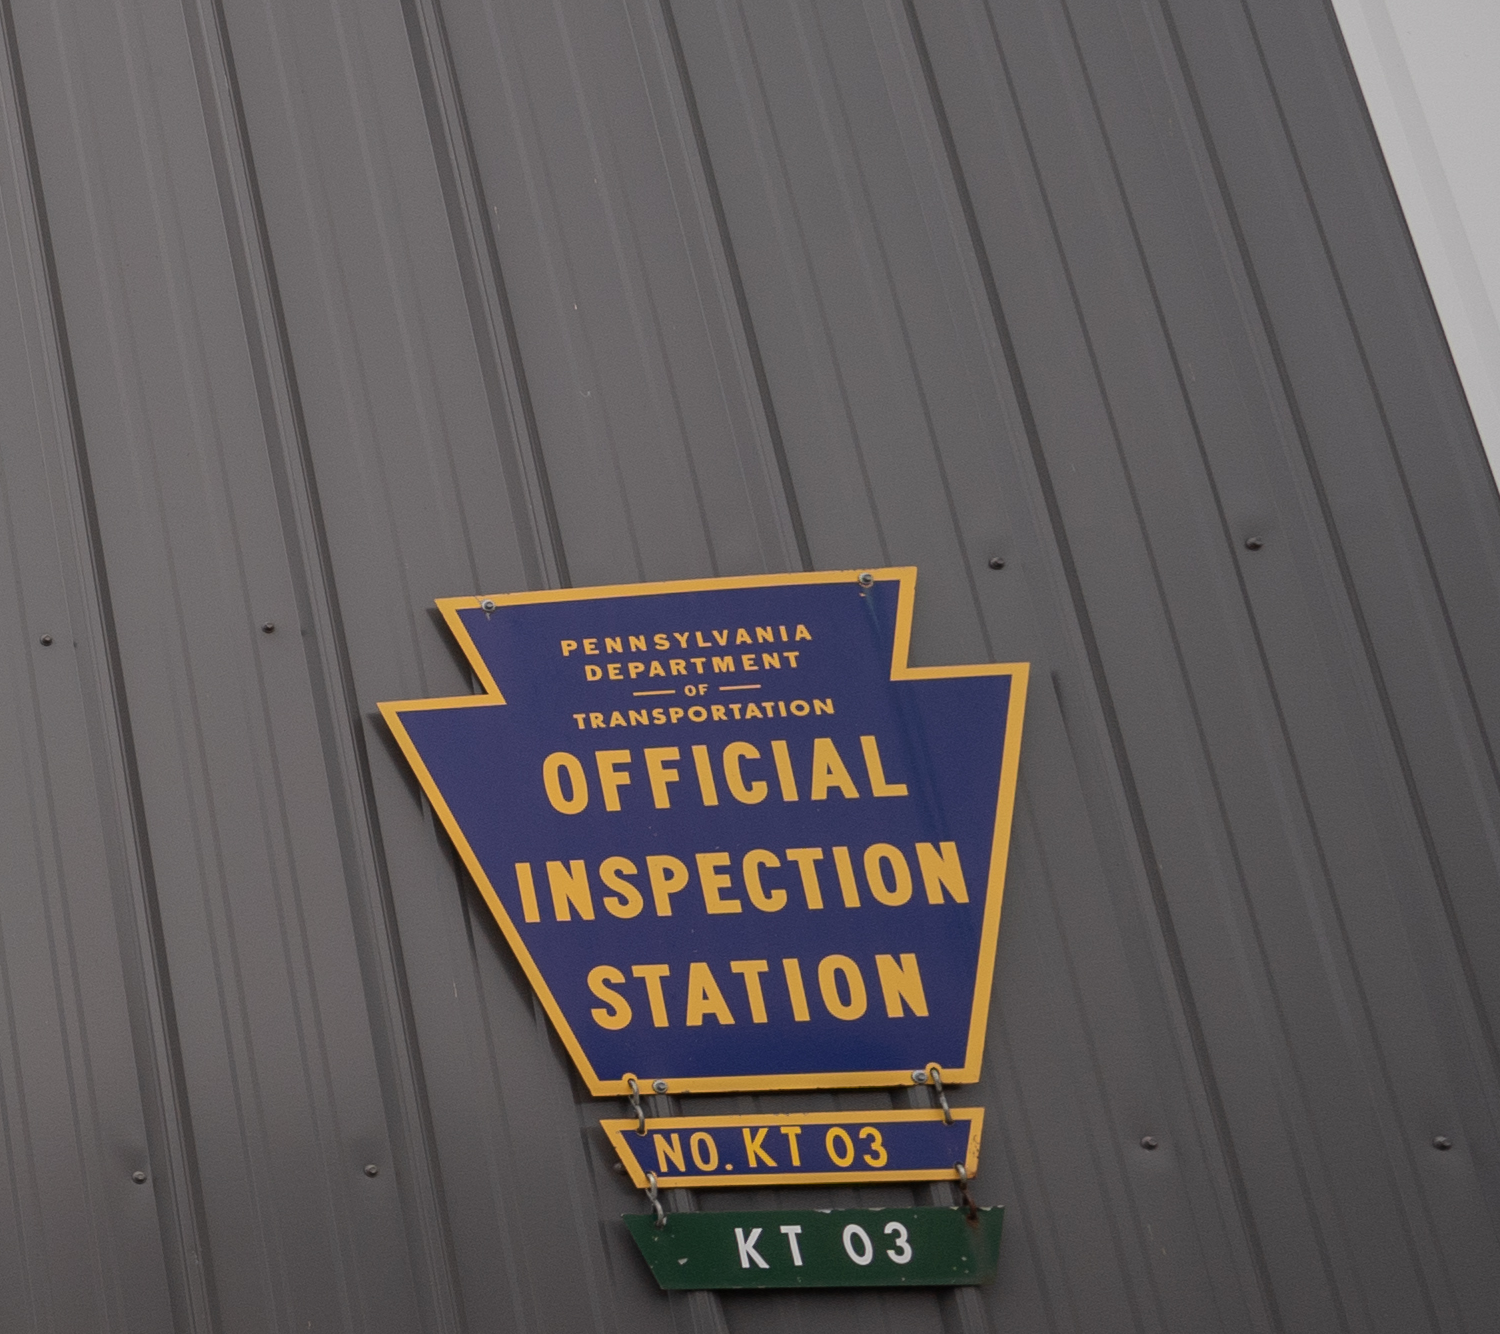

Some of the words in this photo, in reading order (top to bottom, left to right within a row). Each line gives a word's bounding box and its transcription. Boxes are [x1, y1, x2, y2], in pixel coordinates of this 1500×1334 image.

[561, 624, 813, 656] PENNSYLVANIA
[584, 652, 800, 681] DEPARTMENT
[684, 683, 708, 697] OF
[573, 698, 835, 729] TRANSPORTATION
[542, 735, 908, 815] OFFICIAL
[515, 841, 969, 923] INSPECTION
[590, 953, 929, 1031] STATION
[825, 1126, 889, 1168] 03
[734, 1225, 806, 1270] KT
[842, 1221, 913, 1266] 03
